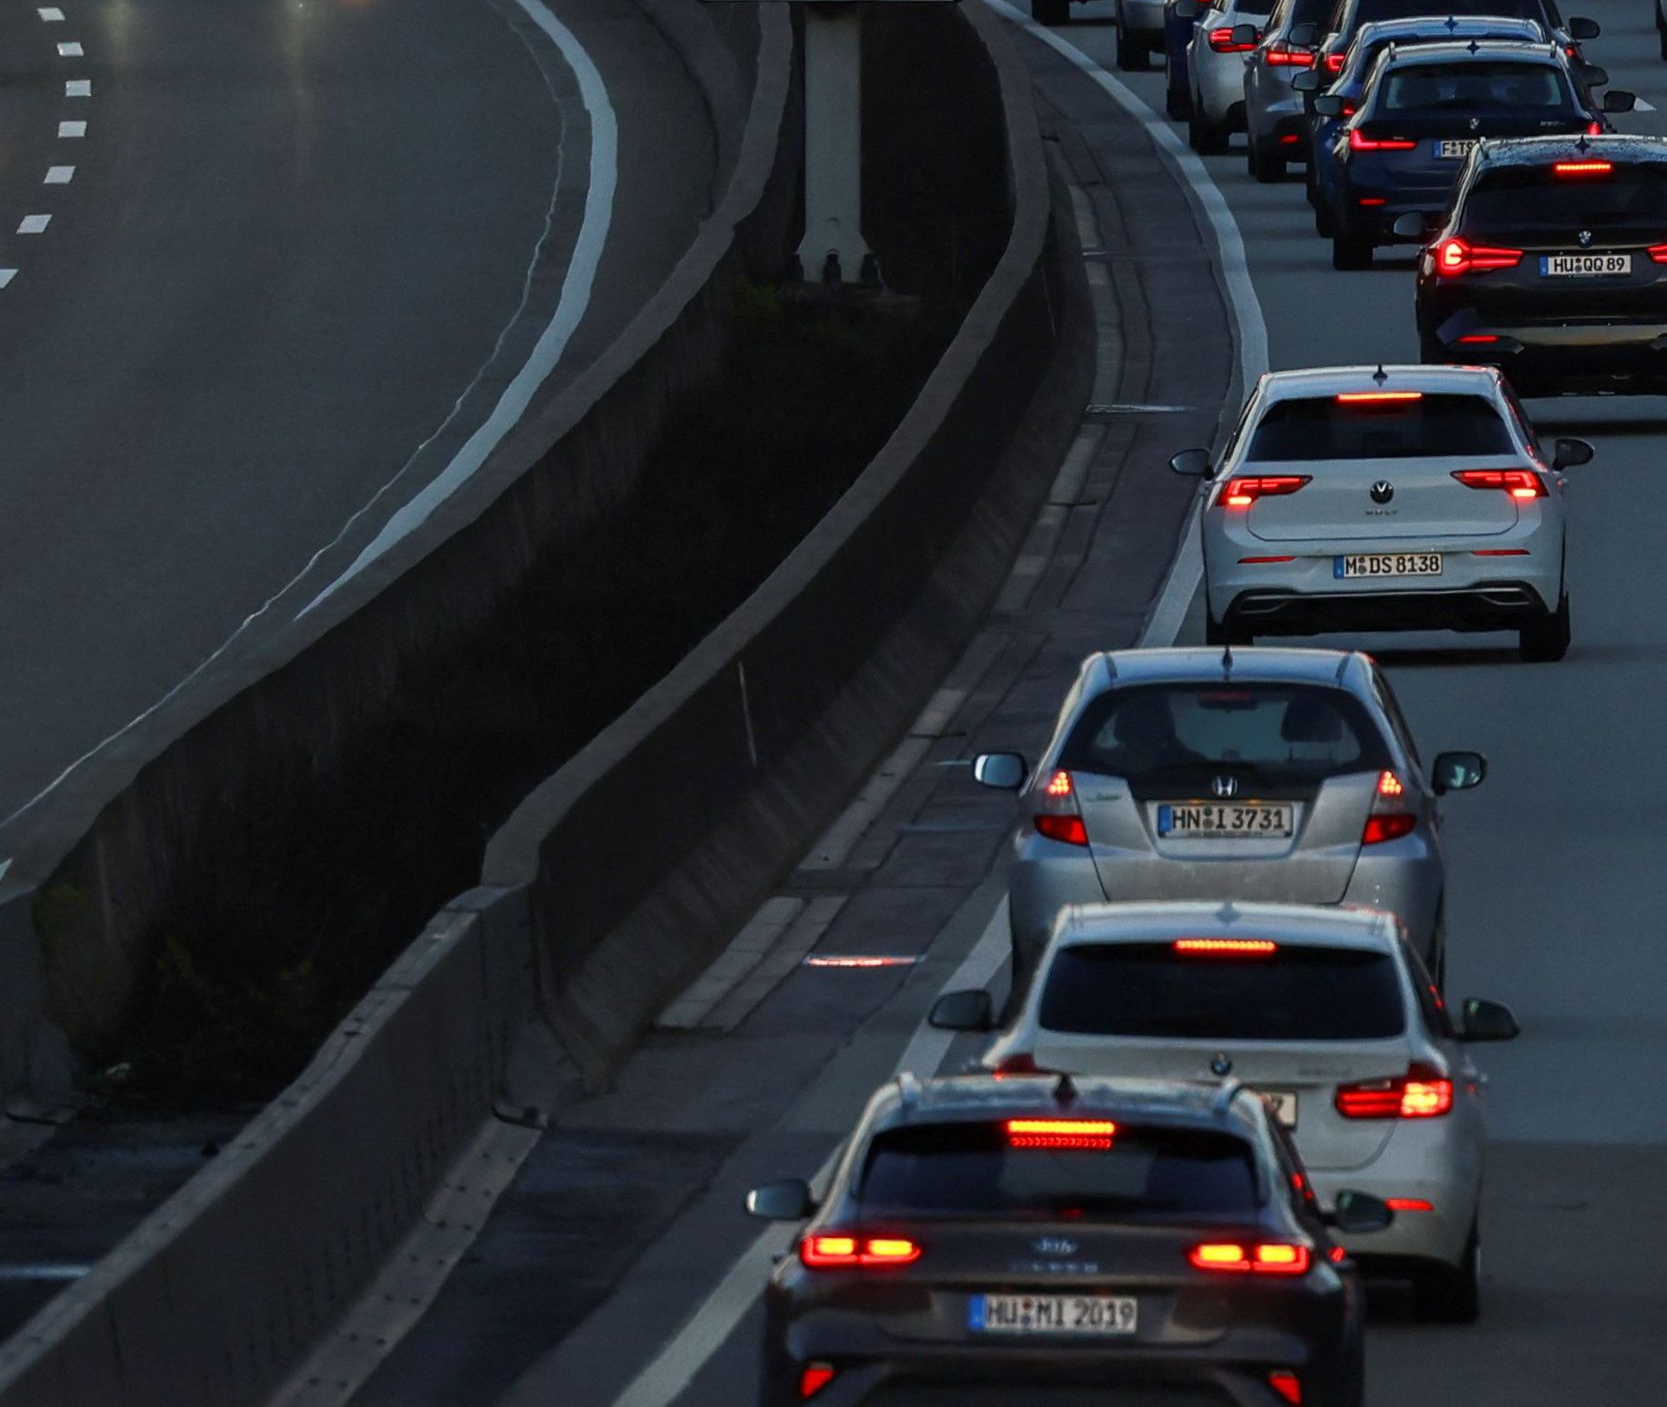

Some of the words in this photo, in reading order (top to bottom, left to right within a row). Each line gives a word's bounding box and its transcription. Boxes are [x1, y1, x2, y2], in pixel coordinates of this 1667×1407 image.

[1442, 141, 1451, 154] F
[1553, 258, 1574, 273] HU
[1583, 257, 1604, 272] QQ
[1606, 257, 1625, 271] 89
[1345, 557, 1357, 575] M
[1369, 556, 1393, 574] DS
[1396, 555, 1440, 573] 8138
[1172, 808, 1200, 830] HN
[1231, 808, 1285, 829] 3731
[988, 1300, 1018, 1324] HU
[1072, 1299, 1135, 1326] 2019
